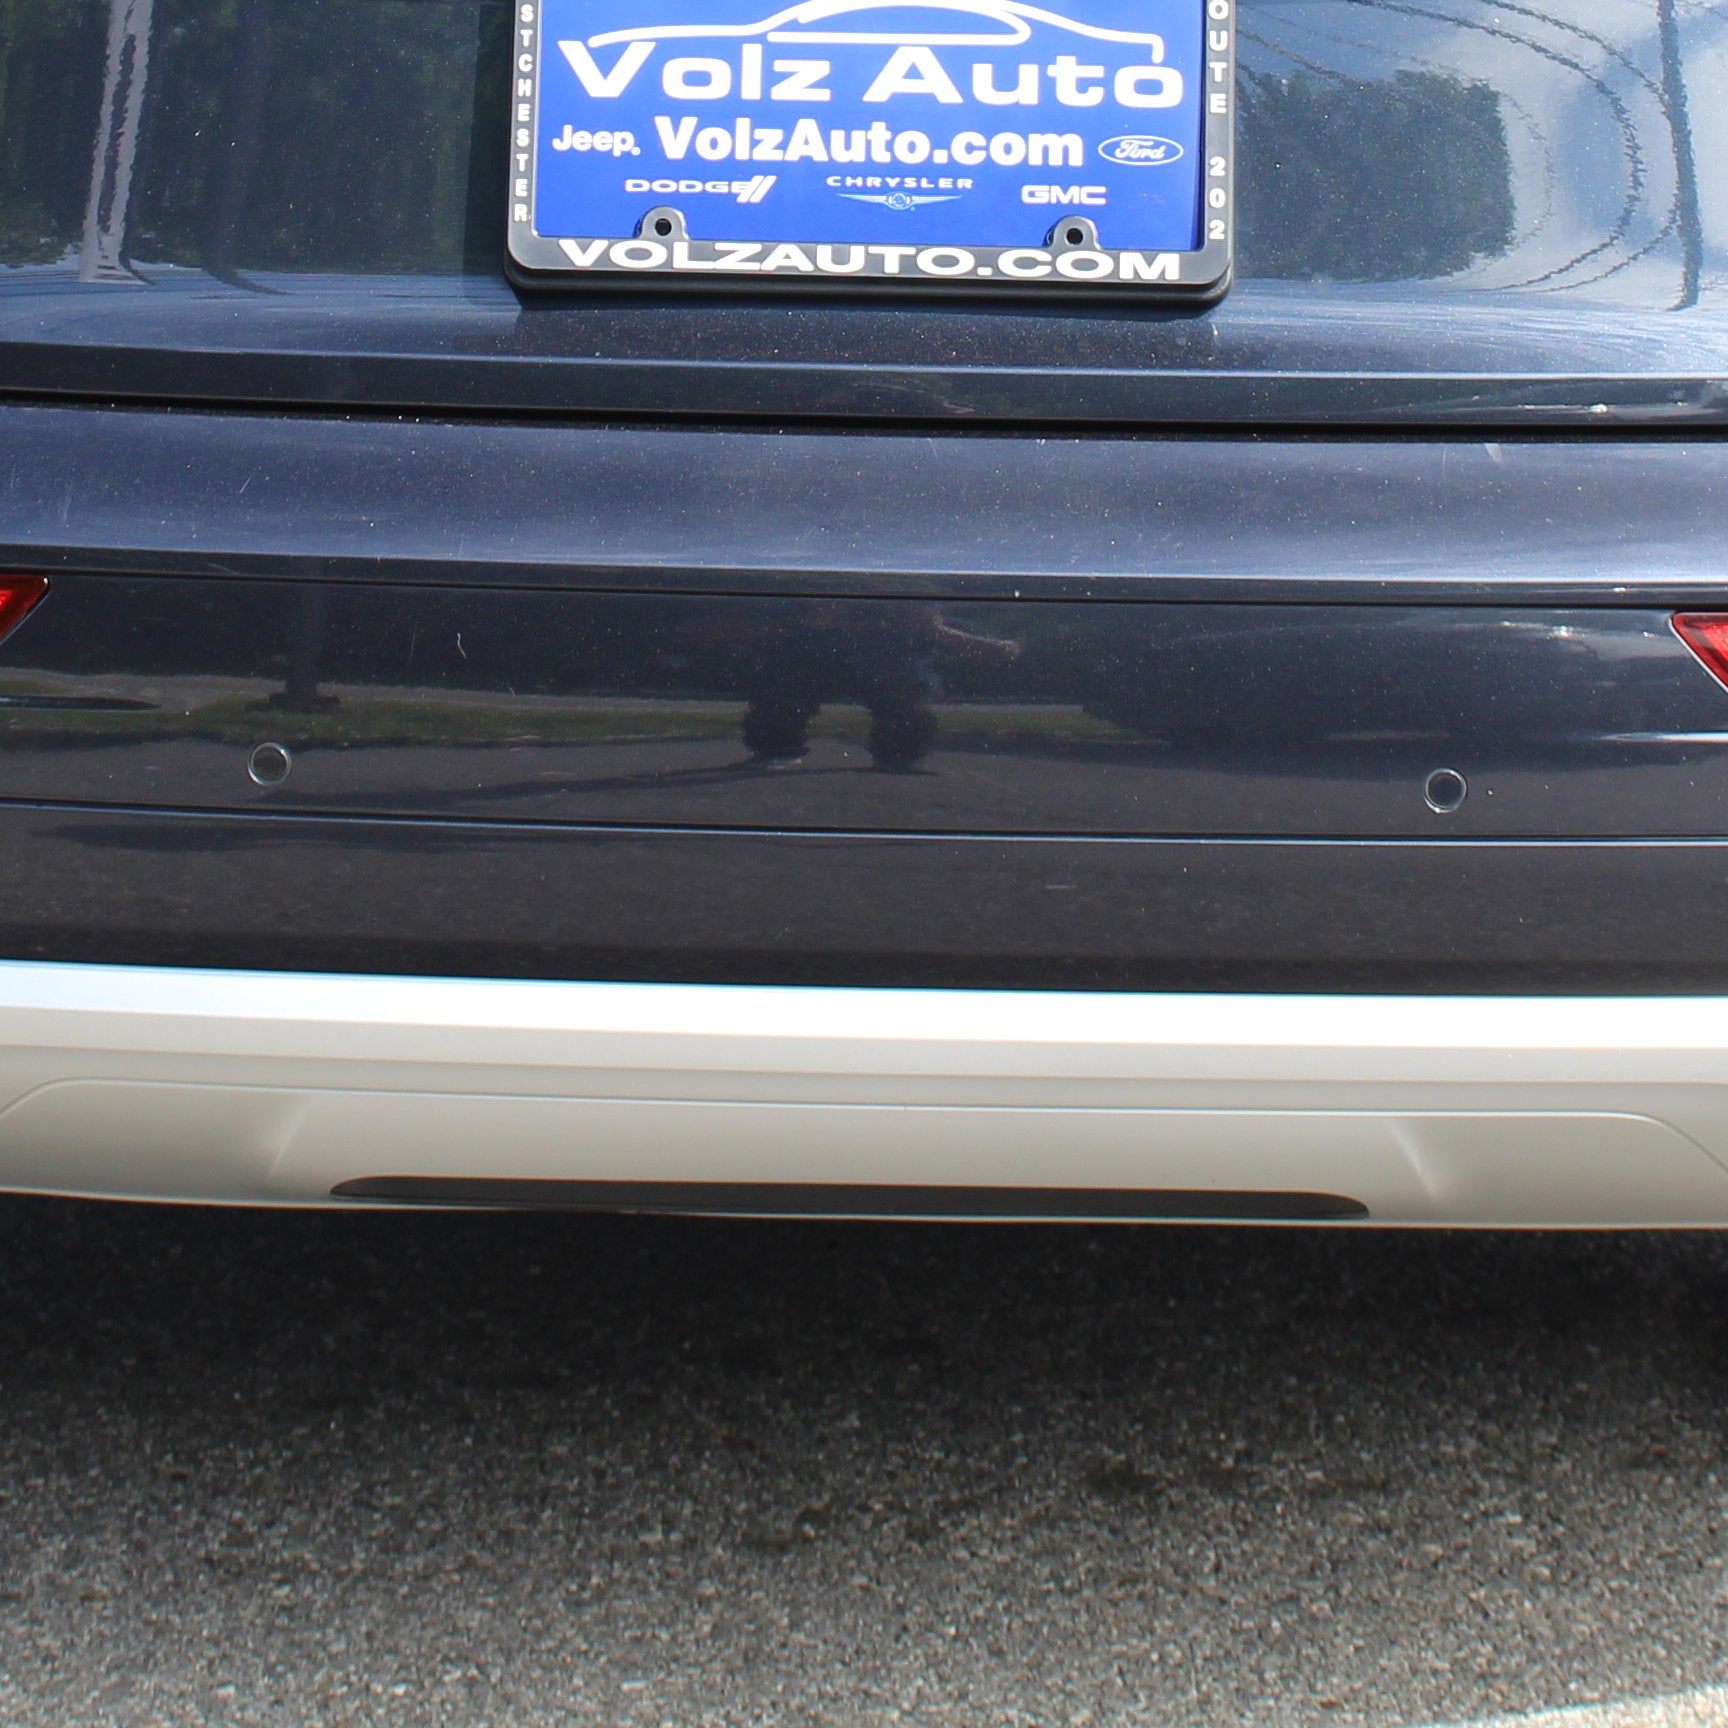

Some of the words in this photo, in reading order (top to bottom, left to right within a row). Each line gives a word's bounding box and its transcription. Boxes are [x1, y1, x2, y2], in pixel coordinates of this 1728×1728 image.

[557, 40, 832, 102] Volz
[862, 46, 1183, 108] Auto
[654, 116, 1083, 166] VolzAuto.com
[1115, 139, 1167, 159] Ford
[625, 178, 751, 194] DODGE
[826, 176, 974, 190] CHRYSLER
[1022, 185, 1107, 205] GMC
[1209, 156, 1226, 240] 202
[558, 239, 1180, 281] VOLZAUTO.COM
